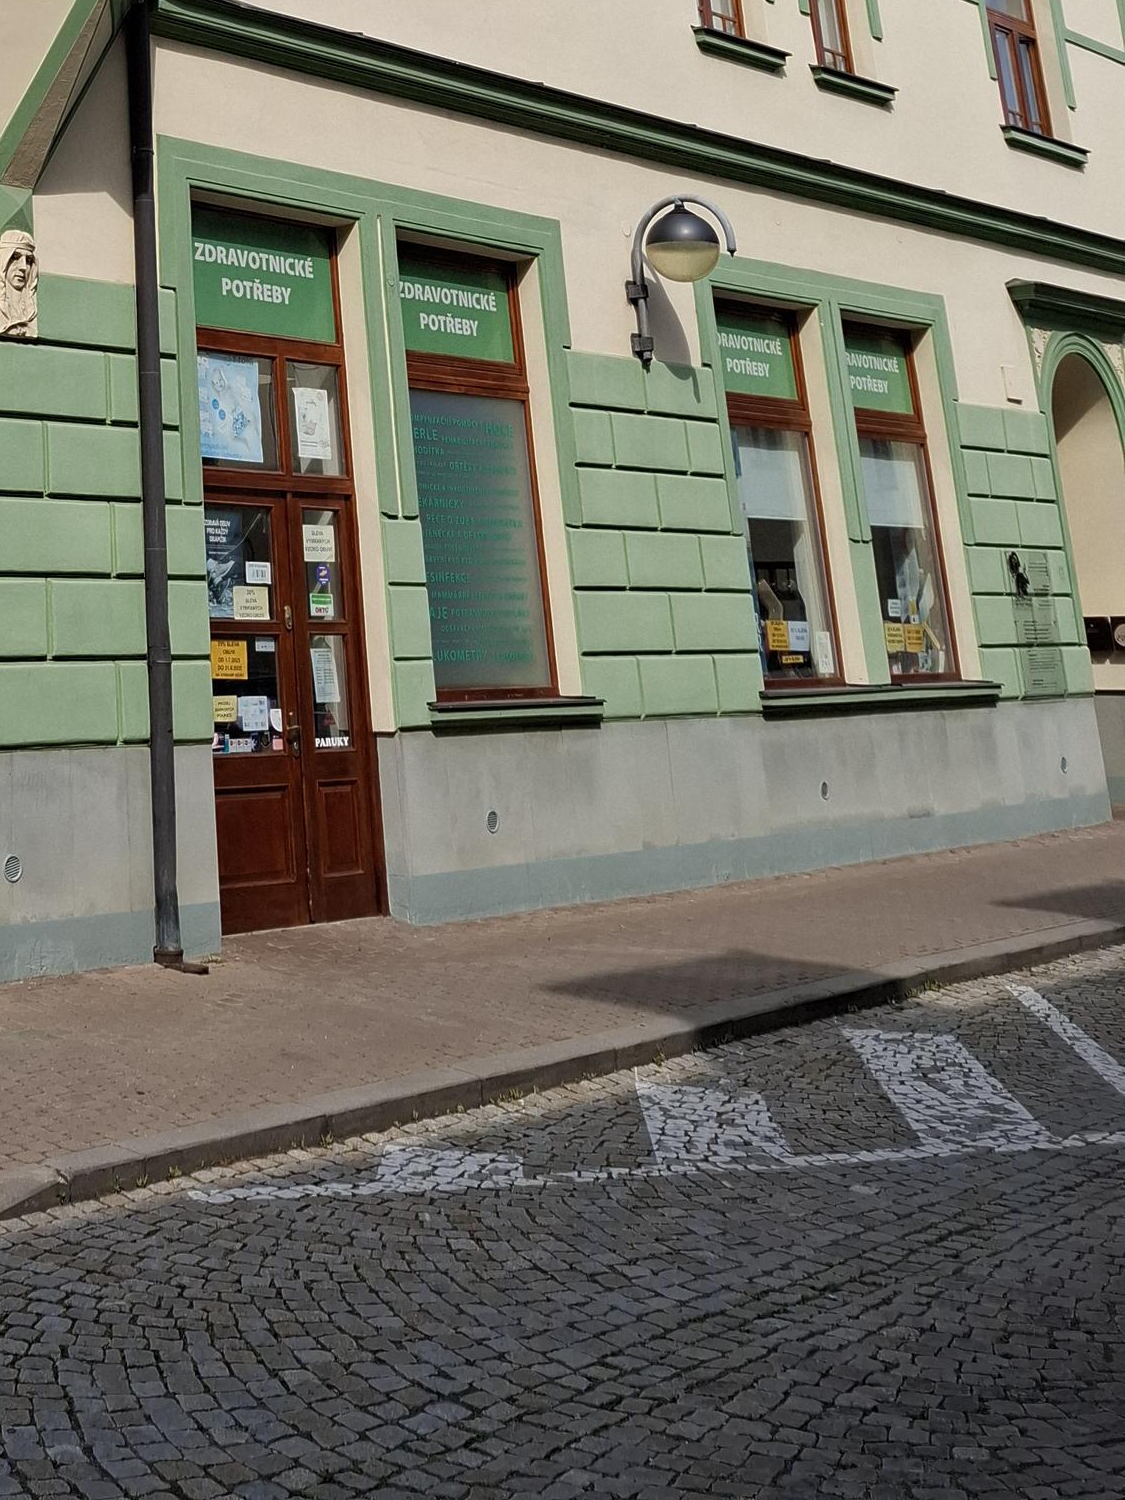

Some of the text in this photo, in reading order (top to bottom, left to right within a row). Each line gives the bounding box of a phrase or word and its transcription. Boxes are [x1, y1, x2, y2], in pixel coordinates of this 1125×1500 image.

[194, 242, 314, 279] ZDRAVOTNICKÉ
[221, 278, 291, 305] POTŘEBY
[419, 312, 478, 337] POTŘEBY
[726, 357, 769, 378] POTŘEBY
[850, 375, 888, 394] POTŘEBY
[315, 736, 349, 748] PARUKY
